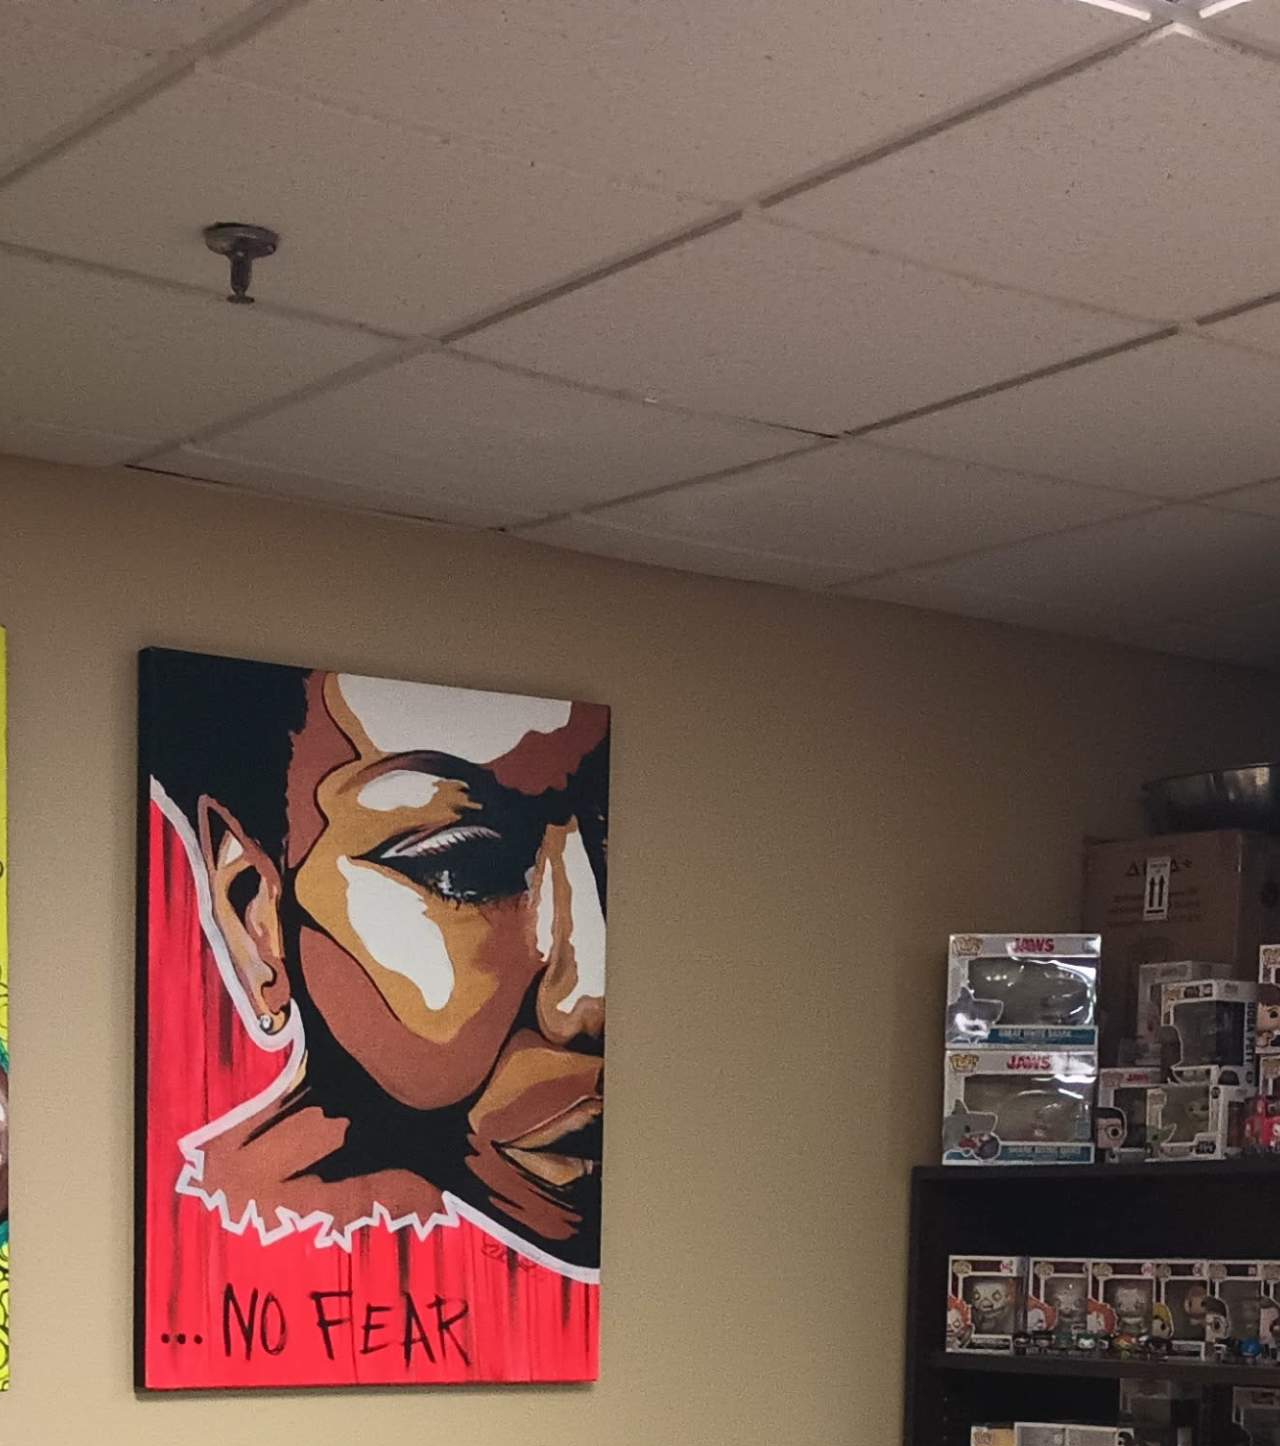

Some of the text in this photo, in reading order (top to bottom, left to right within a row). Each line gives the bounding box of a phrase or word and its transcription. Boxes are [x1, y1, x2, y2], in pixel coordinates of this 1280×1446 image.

[1014, 937, 1055, 953] JAWS
[1007, 1055, 1052, 1070] JAWS
[310, 1289, 472, 1369] FEAR
